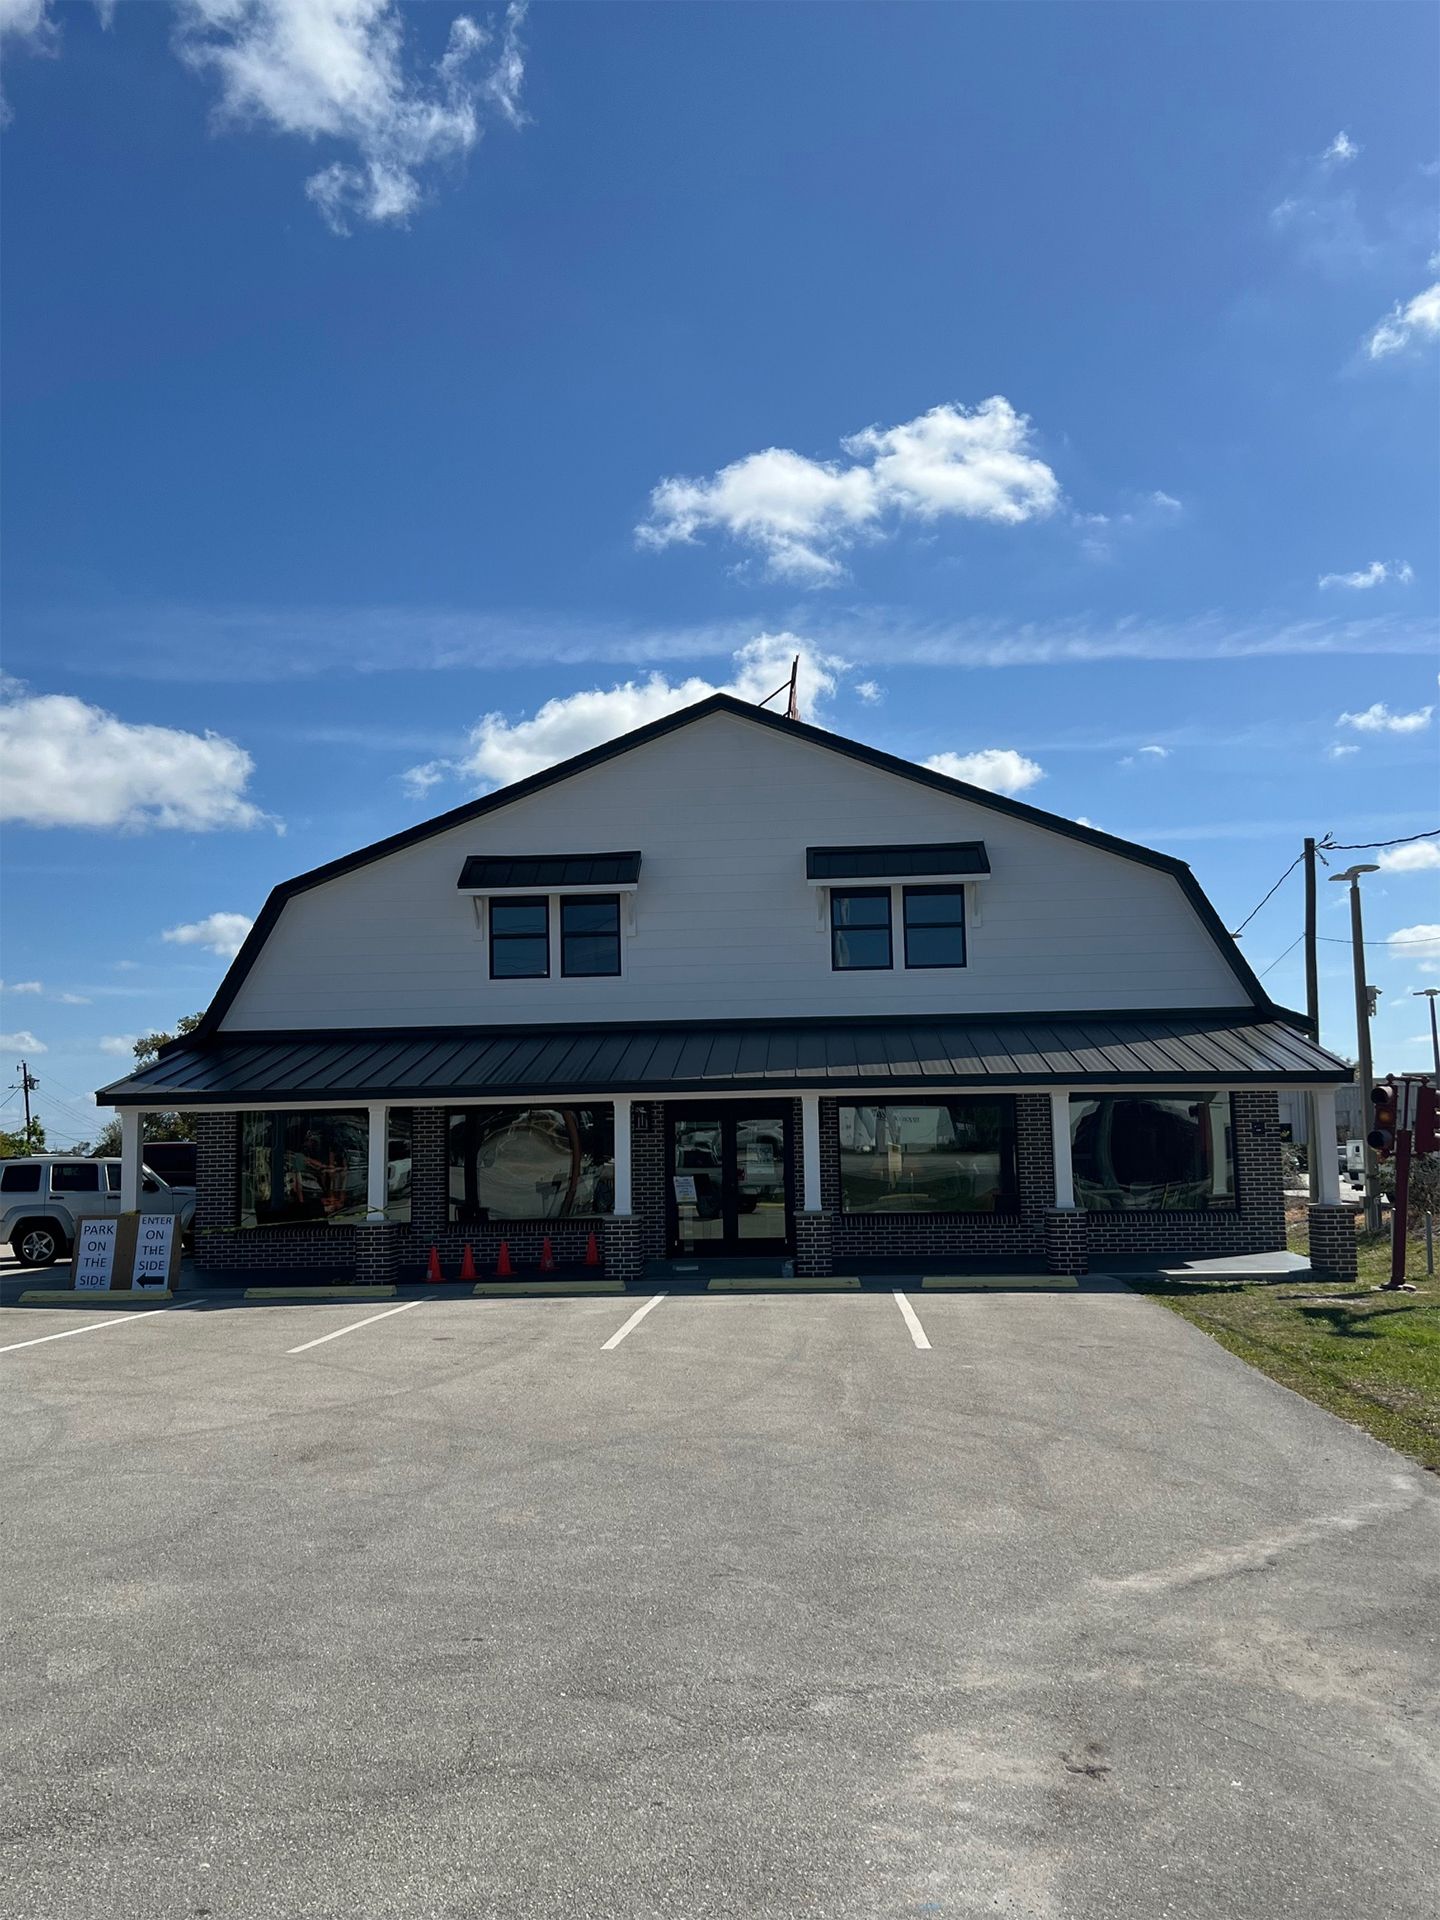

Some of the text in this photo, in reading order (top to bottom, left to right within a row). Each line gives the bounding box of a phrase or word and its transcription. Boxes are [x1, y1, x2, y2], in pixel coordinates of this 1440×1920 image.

[142, 1217, 172, 1225] ENTER
[84, 1225, 114, 1235] PARK
[146, 1230, 165, 1240] ON
[87, 1241, 106, 1252] ON
[143, 1245, 165, 1255] THE
[84, 1257, 107, 1268] THE
[138, 1261, 165, 1271] SIDE
[79, 1275, 106, 1286] SIDE
